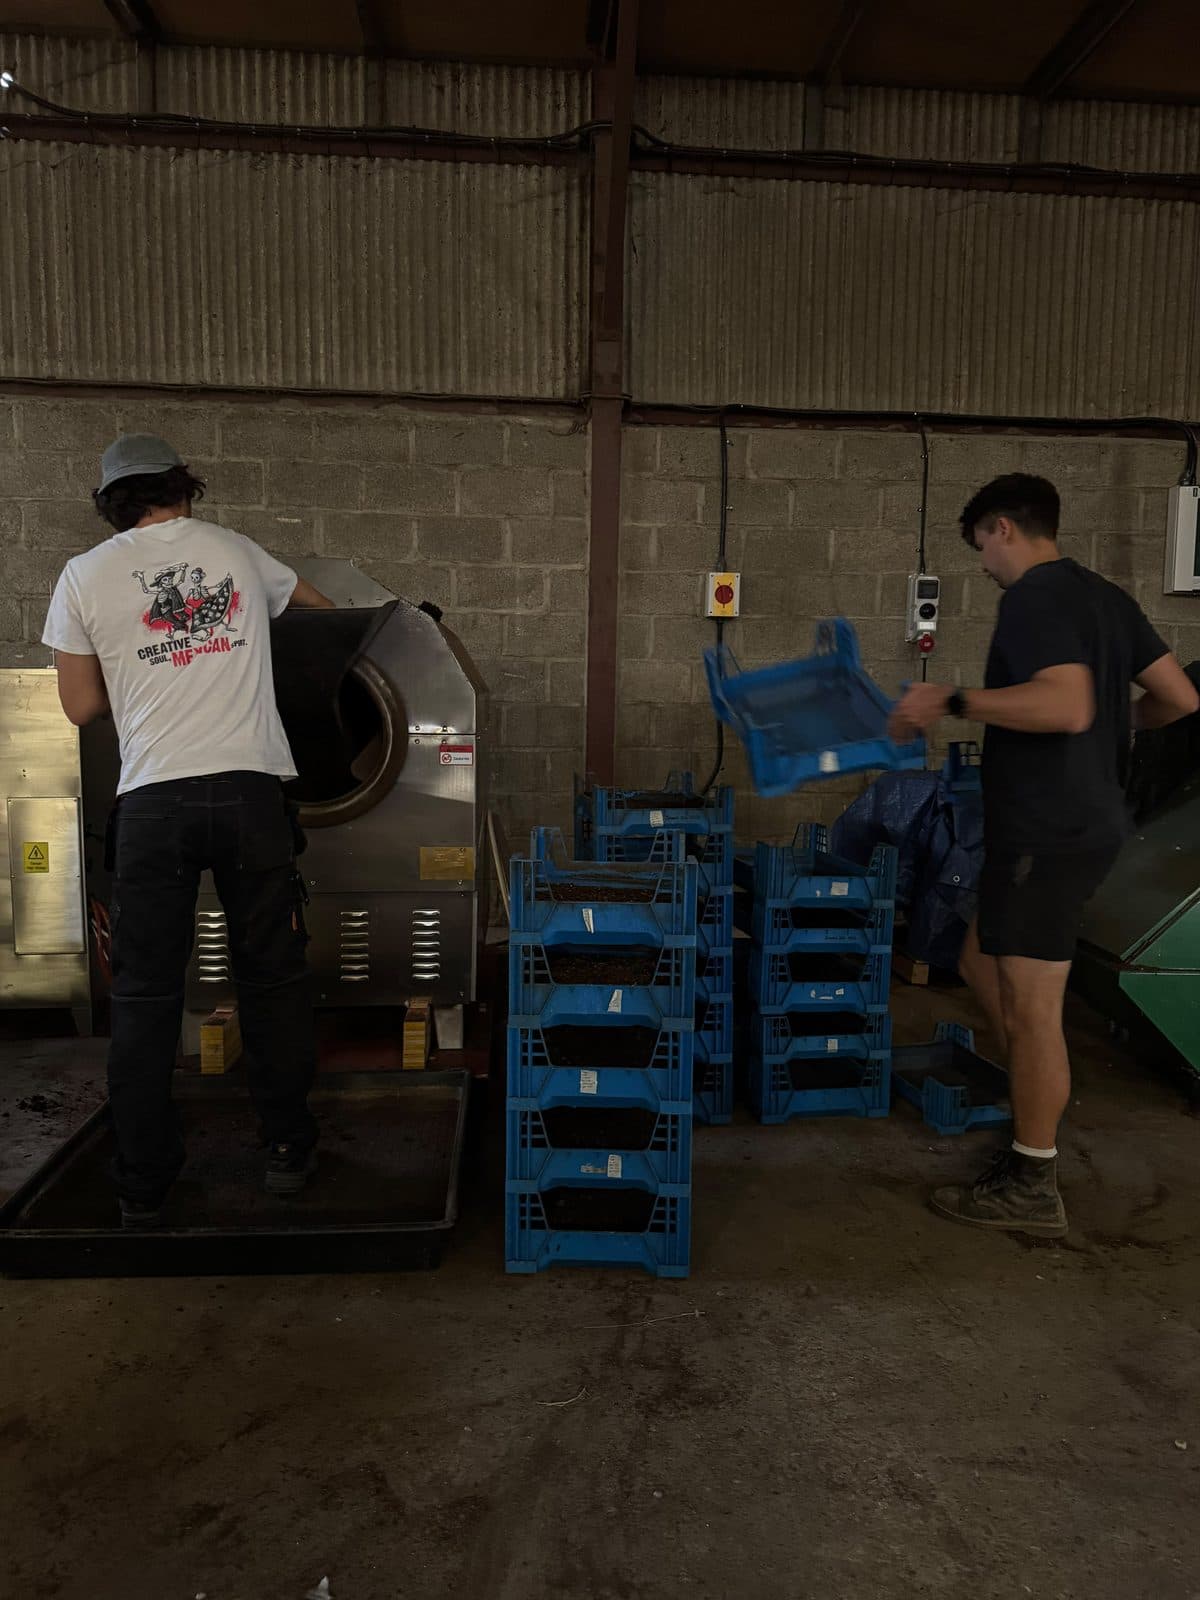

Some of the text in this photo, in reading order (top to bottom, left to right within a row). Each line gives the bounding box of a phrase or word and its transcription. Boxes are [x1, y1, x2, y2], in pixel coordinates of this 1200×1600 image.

[137, 637, 192, 660] CREATIVE
[149, 655, 171, 665] SOUL.
[172, 637, 231, 667] MECAN
